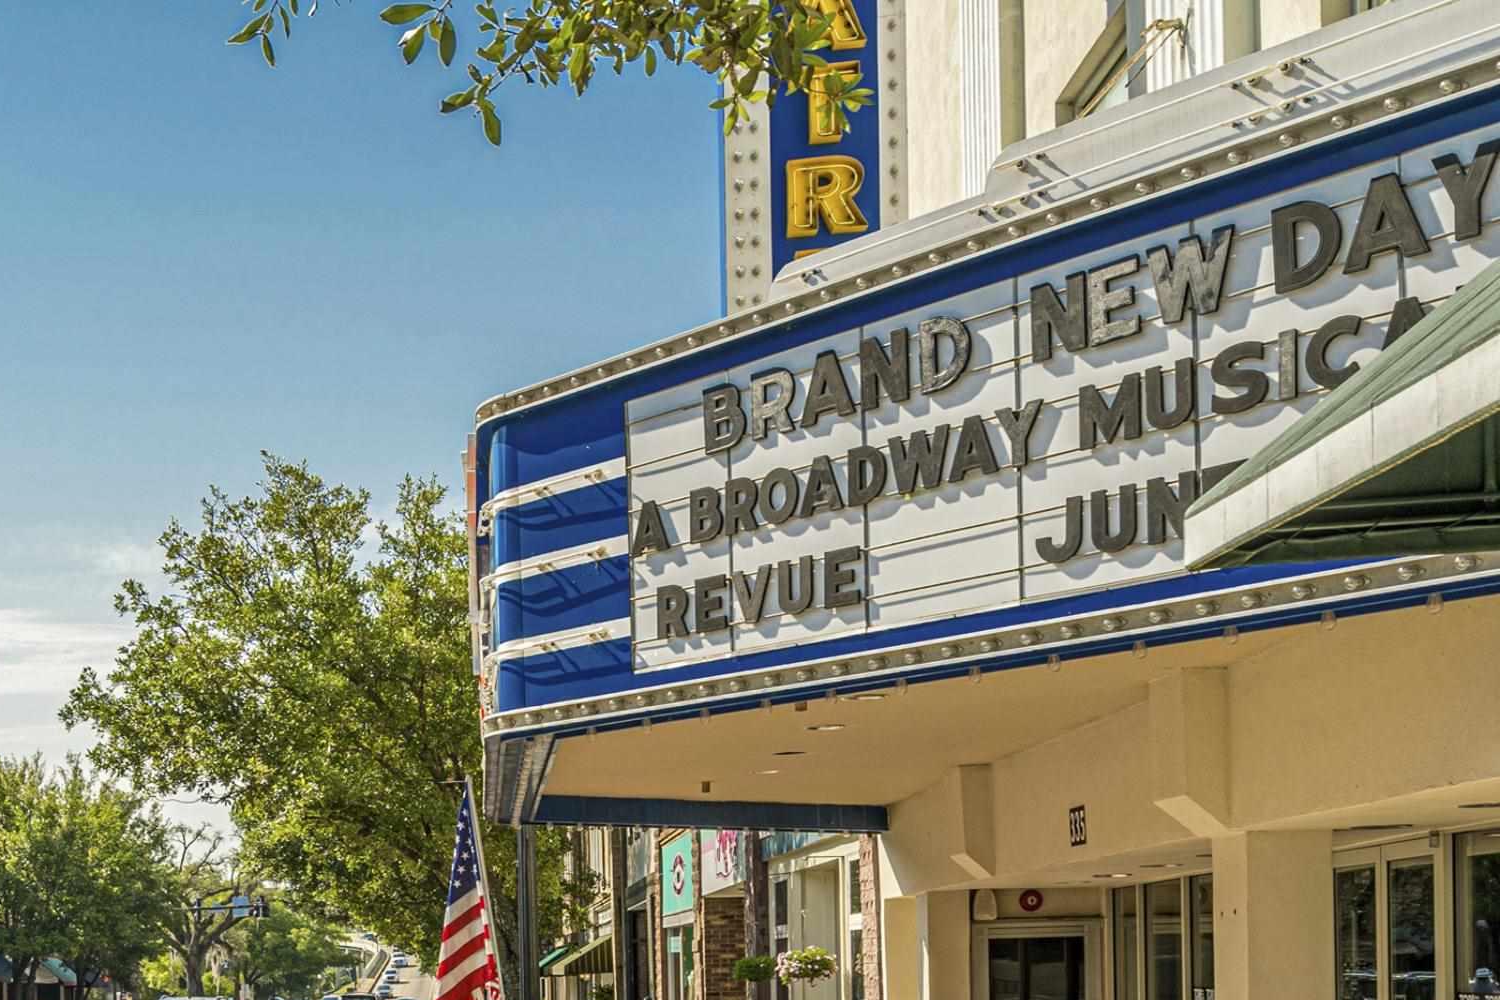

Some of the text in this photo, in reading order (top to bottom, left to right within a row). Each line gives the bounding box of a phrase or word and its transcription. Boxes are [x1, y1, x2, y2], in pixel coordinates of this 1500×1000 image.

[702, 140, 1500, 455] BRAND NEW DAY
[633, 500, 670, 556] A
[690, 399, 1044, 544] BROADWAY
[657, 459, 1248, 639] REVUE JUN
